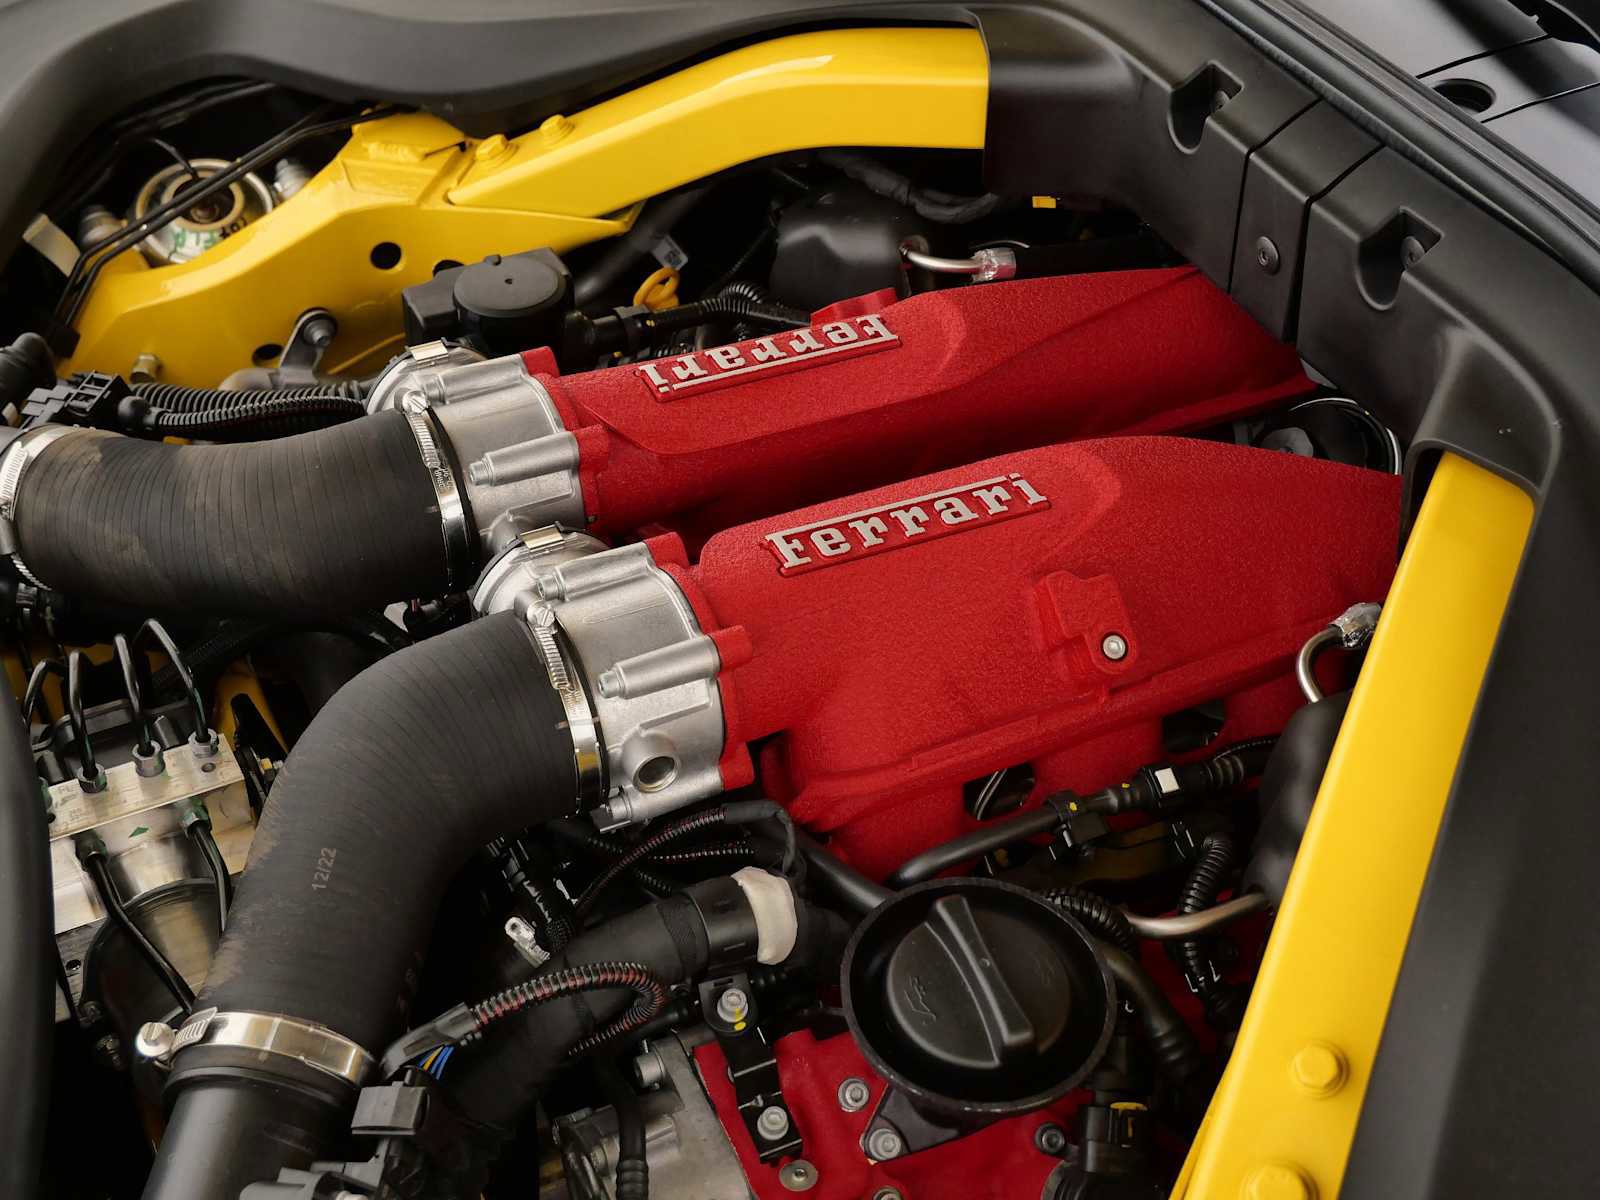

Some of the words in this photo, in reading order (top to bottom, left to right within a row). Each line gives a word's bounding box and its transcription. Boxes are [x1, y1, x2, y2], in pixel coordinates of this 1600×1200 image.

[638, 313, 899, 393] Ferrari
[764, 472, 1048, 569] Ferrari
[311, 847, 337, 891] 12/22
